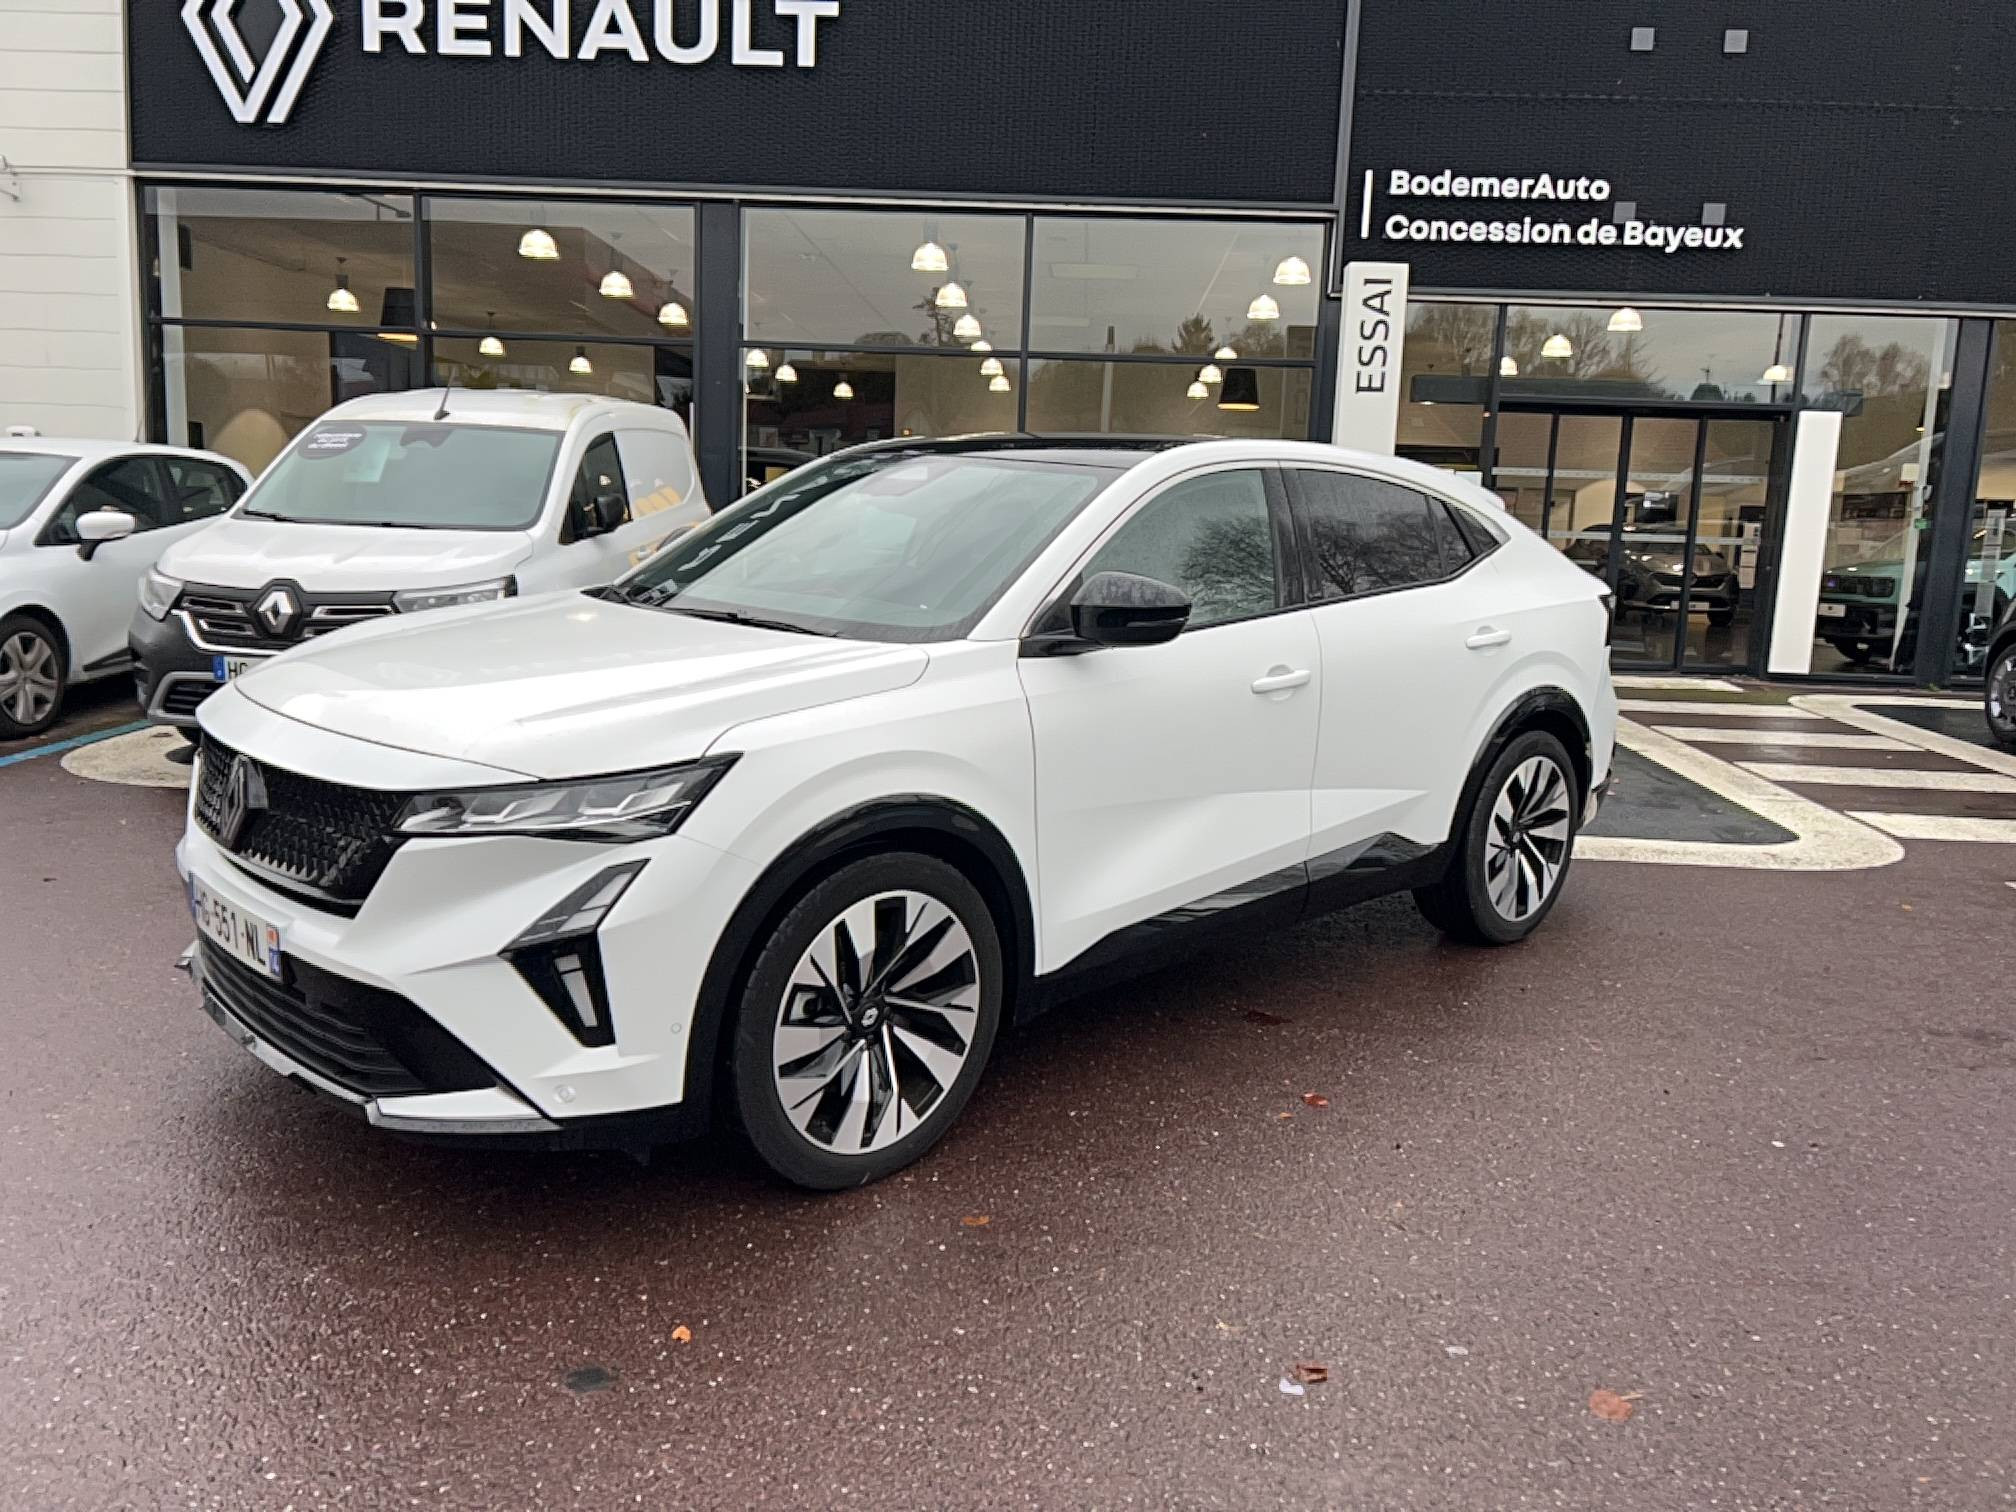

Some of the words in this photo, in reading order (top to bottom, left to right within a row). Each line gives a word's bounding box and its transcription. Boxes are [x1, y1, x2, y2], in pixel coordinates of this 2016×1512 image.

[362, 0, 840, 67] RENAULT
[1389, 169, 1611, 201] BodemerAuto
[1385, 214, 1571, 244] Concession
[1576, 218, 1618, 246] de
[1623, 221, 1744, 254] Bayeux
[1356, 278, 1395, 395] ESSAI
